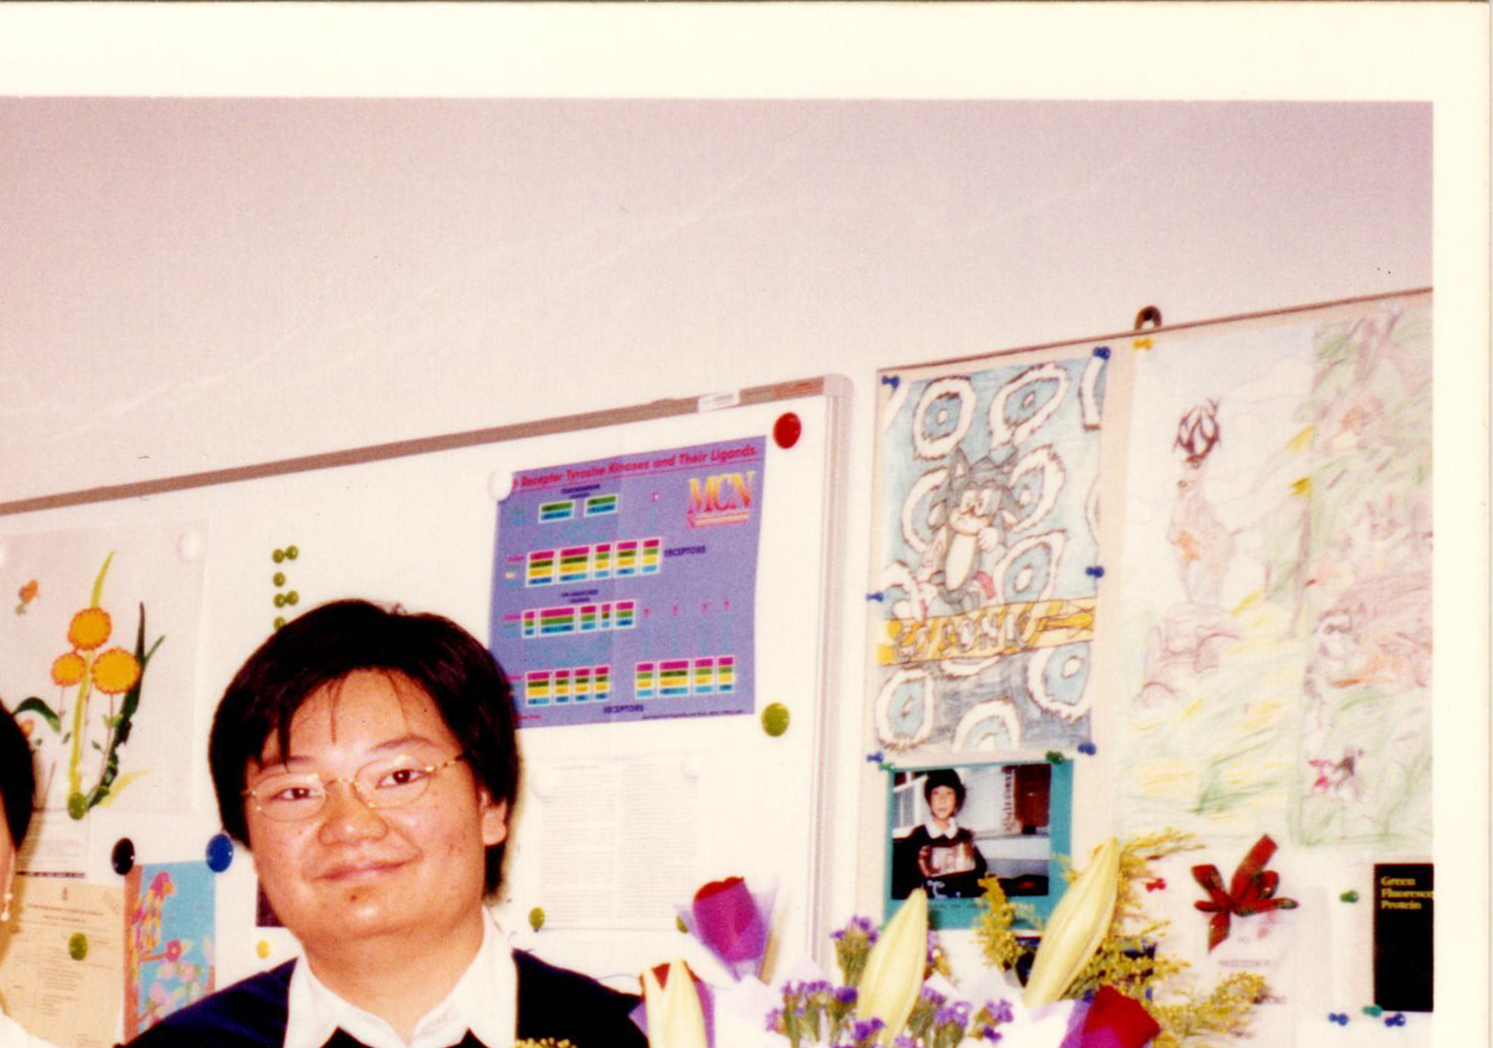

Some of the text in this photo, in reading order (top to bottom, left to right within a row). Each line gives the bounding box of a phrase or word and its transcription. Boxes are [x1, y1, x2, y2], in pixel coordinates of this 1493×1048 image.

[520, 472, 562, 487] Receptor
[566, 466, 604, 483] Tyrosine
[608, 460, 649, 473] Kinases
[653, 454, 675, 468] and
[679, 452, 707, 464] Their
[687, 470, 756, 513] MCN
[1381, 877, 1416, 886] Green
[1381, 900, 1422, 909] Protein
